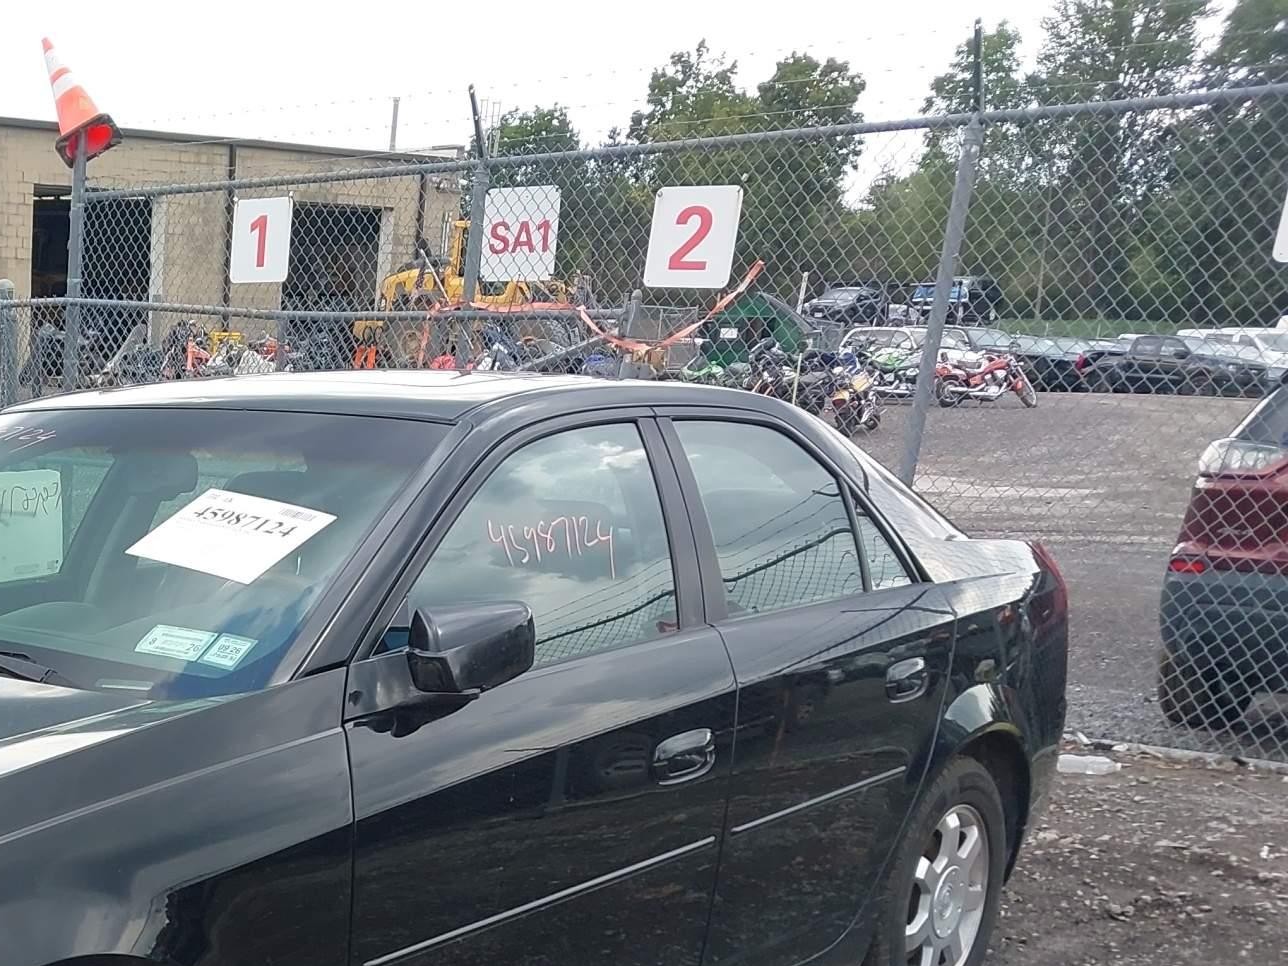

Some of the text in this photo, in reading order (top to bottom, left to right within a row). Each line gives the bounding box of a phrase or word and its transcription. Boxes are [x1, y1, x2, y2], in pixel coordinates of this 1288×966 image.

[249, 214, 268, 268] 1
[489, 218, 551, 255] SA1
[668, 204, 714, 271] 2
[194, 506, 299, 538] 45987124
[487, 515, 616, 581] 45987124
